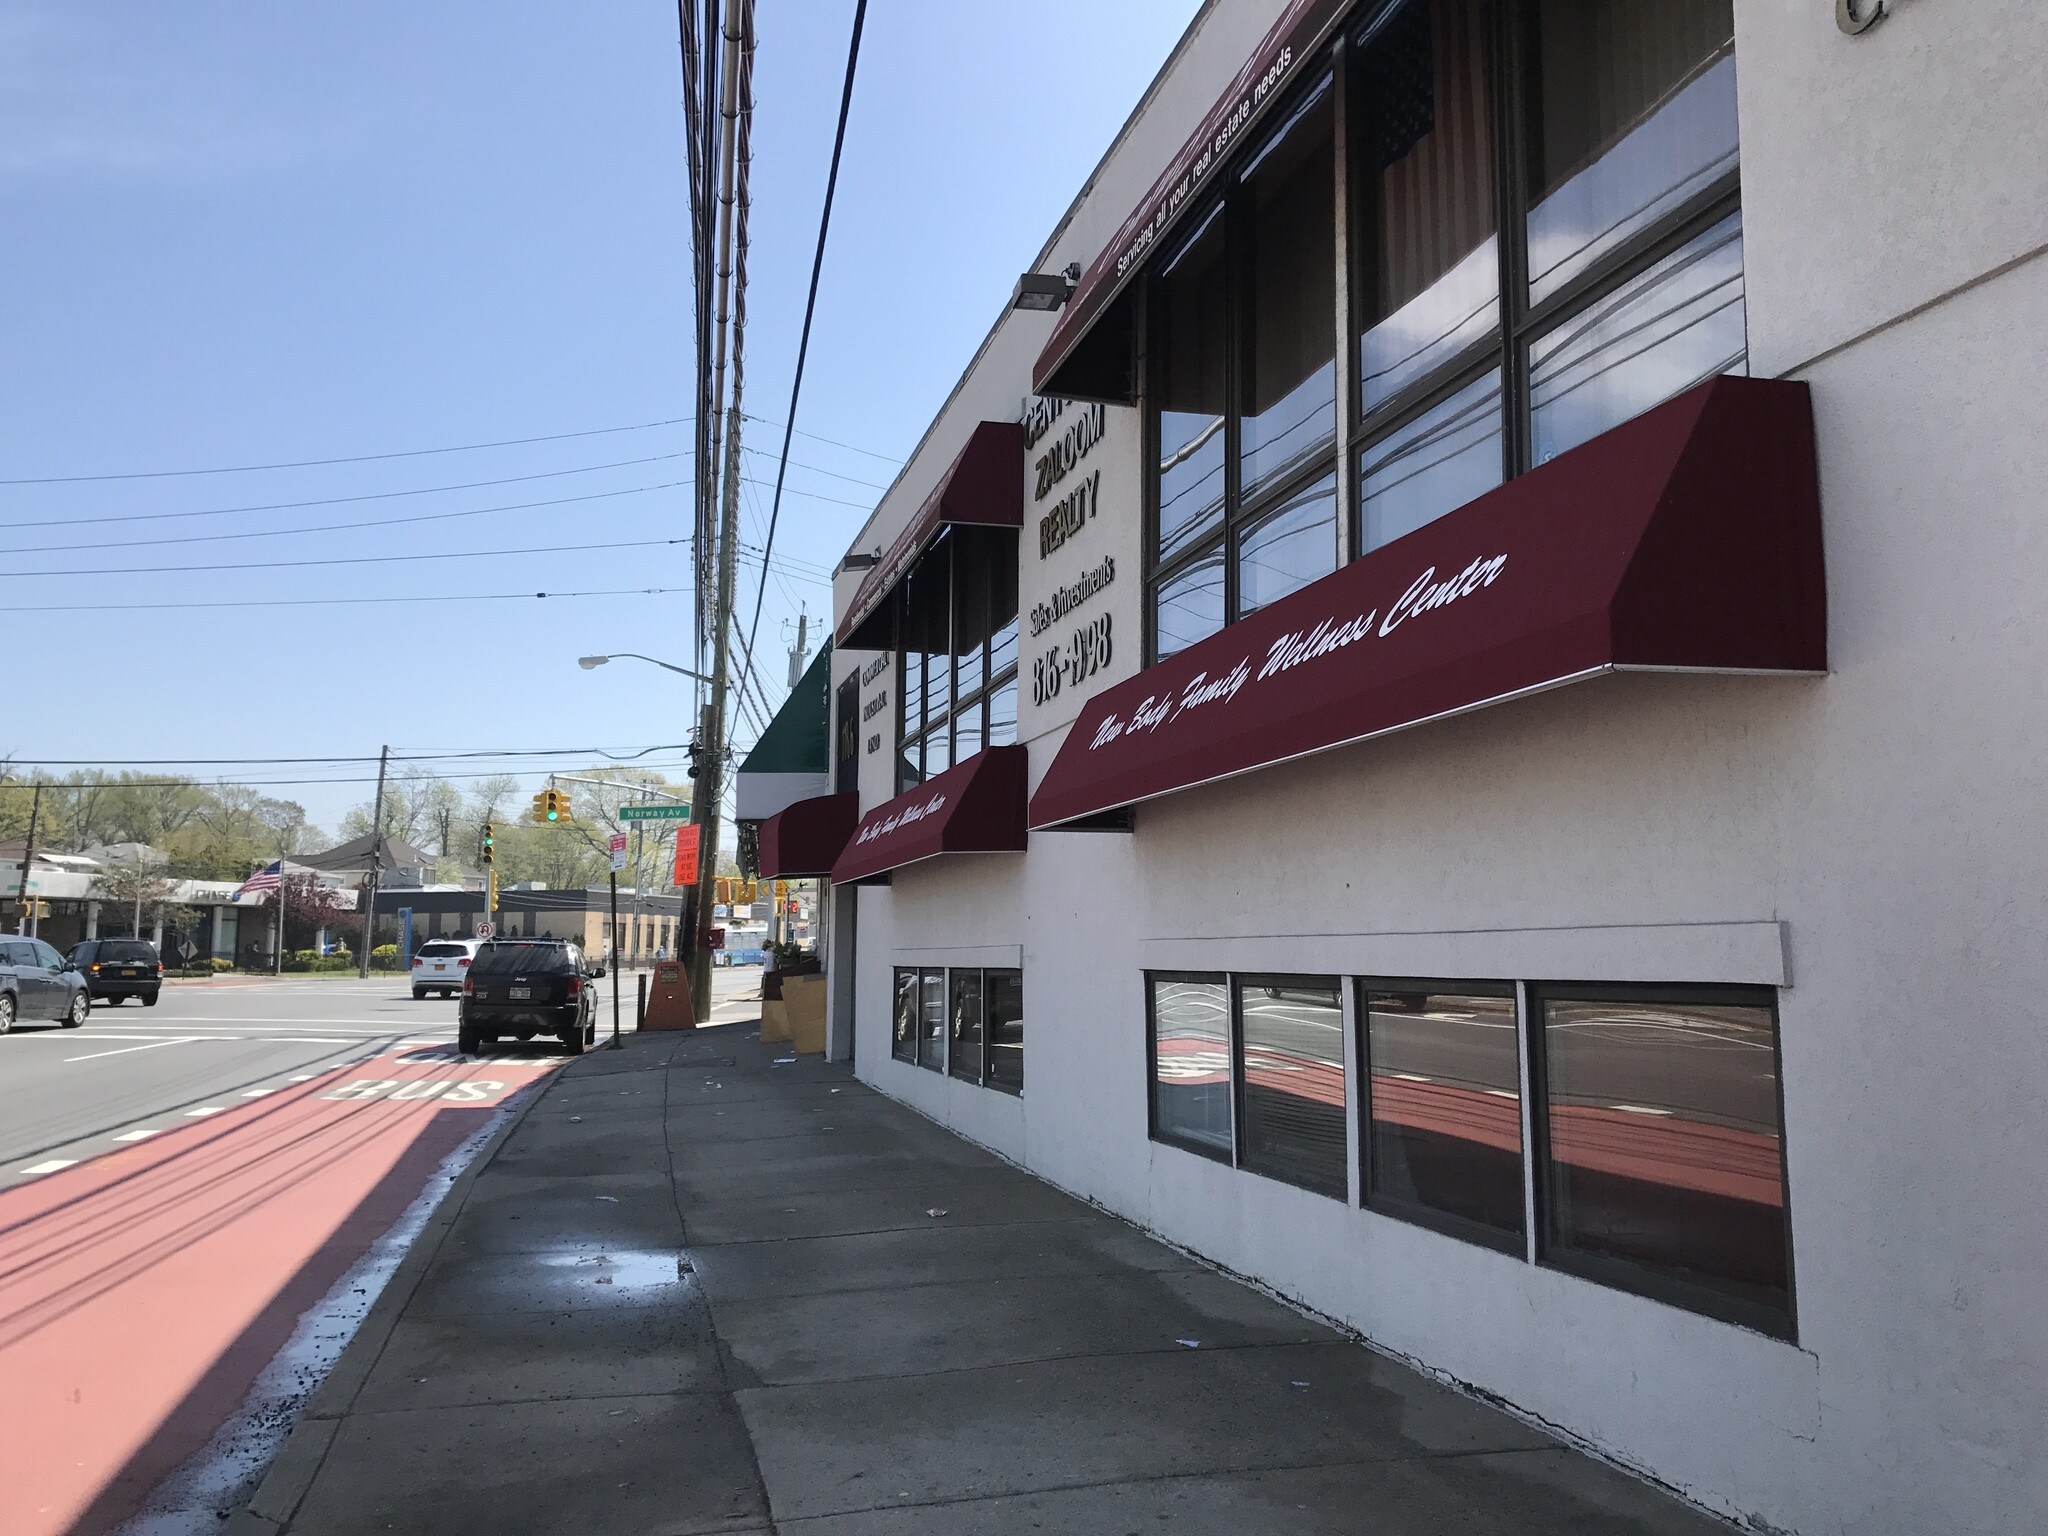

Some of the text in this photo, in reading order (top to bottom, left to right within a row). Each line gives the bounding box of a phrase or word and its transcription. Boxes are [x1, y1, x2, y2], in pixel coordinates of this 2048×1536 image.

[1117, 45, 1292, 277] Servicing all your real estate needs
[1035, 404, 1105, 501] ZALOOM
[1040, 469, 1100, 560] REALTY
[1089, 553, 1508, 750] New Body Family Wellness Center
[627, 807, 681, 818] Norway Av
[397, 917, 406, 949] CHASE
[320, 1079, 504, 1101] BUS
